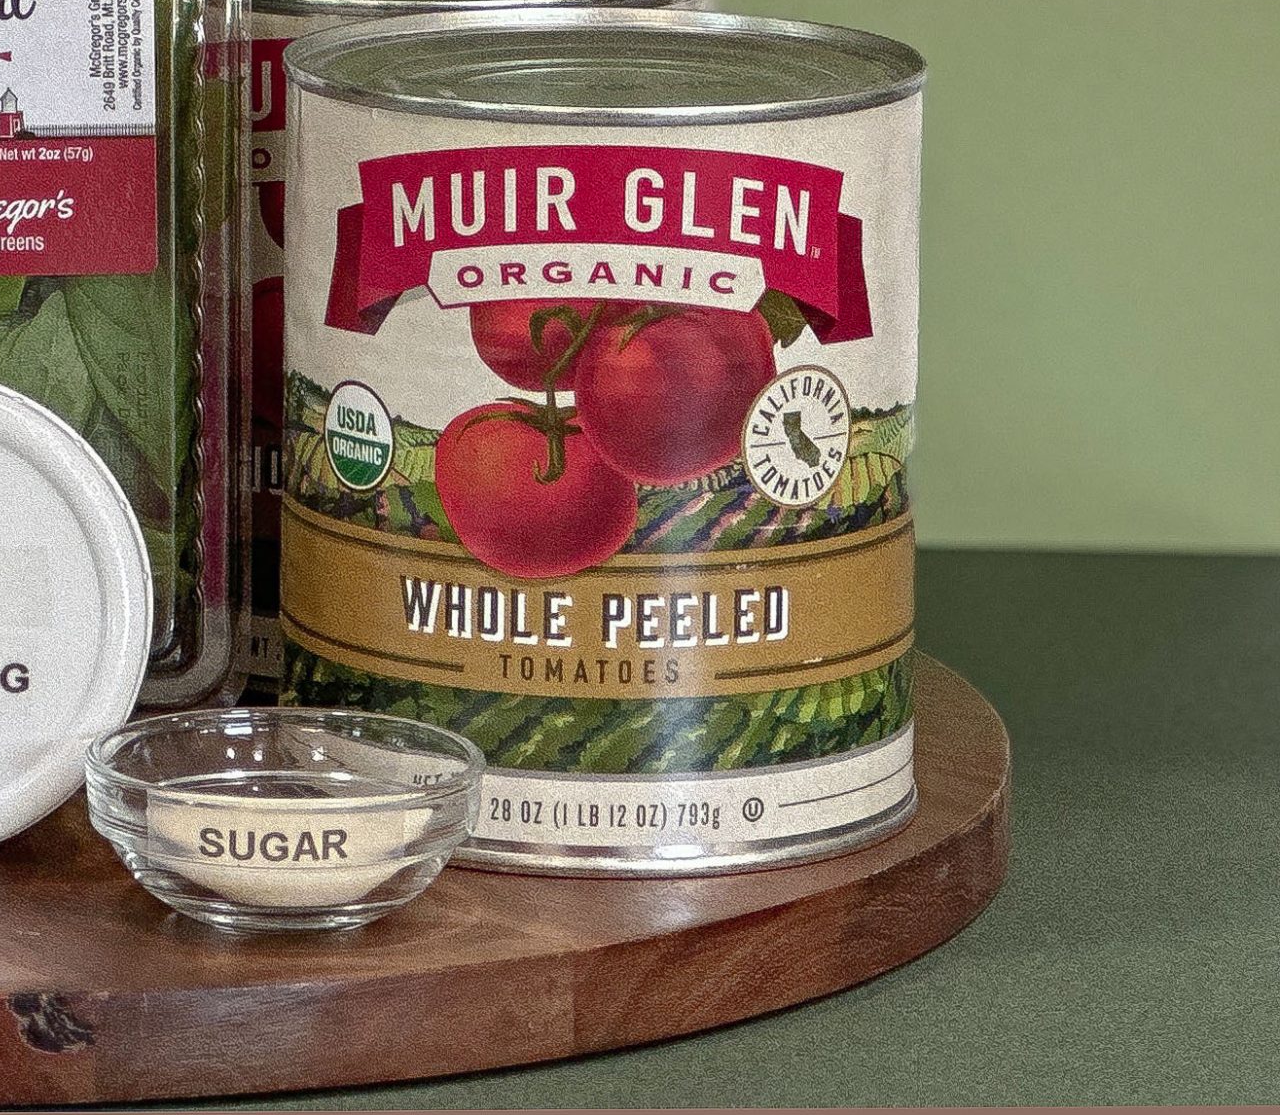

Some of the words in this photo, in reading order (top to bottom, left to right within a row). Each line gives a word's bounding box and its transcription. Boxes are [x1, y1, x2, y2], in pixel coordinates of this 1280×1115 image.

[89, 14, 103, 78] McGregor's
[102, 20, 115, 52] Road,
[102, 54, 115, 79] Britt
[103, 82, 116, 112] 2649
[21, 148, 36, 161] wt
[38, 148, 61, 161] 2oz
[63, 146, 94, 163] (57g)
[392, 165, 578, 248] MUIR
[624, 168, 812, 256] GLEN
[456, 259, 739, 295] ORGANIC
[337, 405, 378, 436] USDA
[752, 376, 845, 437] CALIFORNIA
[332, 436, 383, 466] ORGANIC
[753, 447, 842, 500] TOMATOES
[400, 575, 573, 648] WHOLE
[602, 585, 790, 649] PEELED
[499, 654, 680, 685] TOMATOES
[490, 797, 512, 822] 28
[520, 800, 543, 825] OZ
[577, 802, 600, 827] LB
[609, 803, 627, 828] 12
[635, 802, 668, 830] OZ)
[677, 802, 721, 830] 793g
[198, 827, 348, 862] SUGAR
